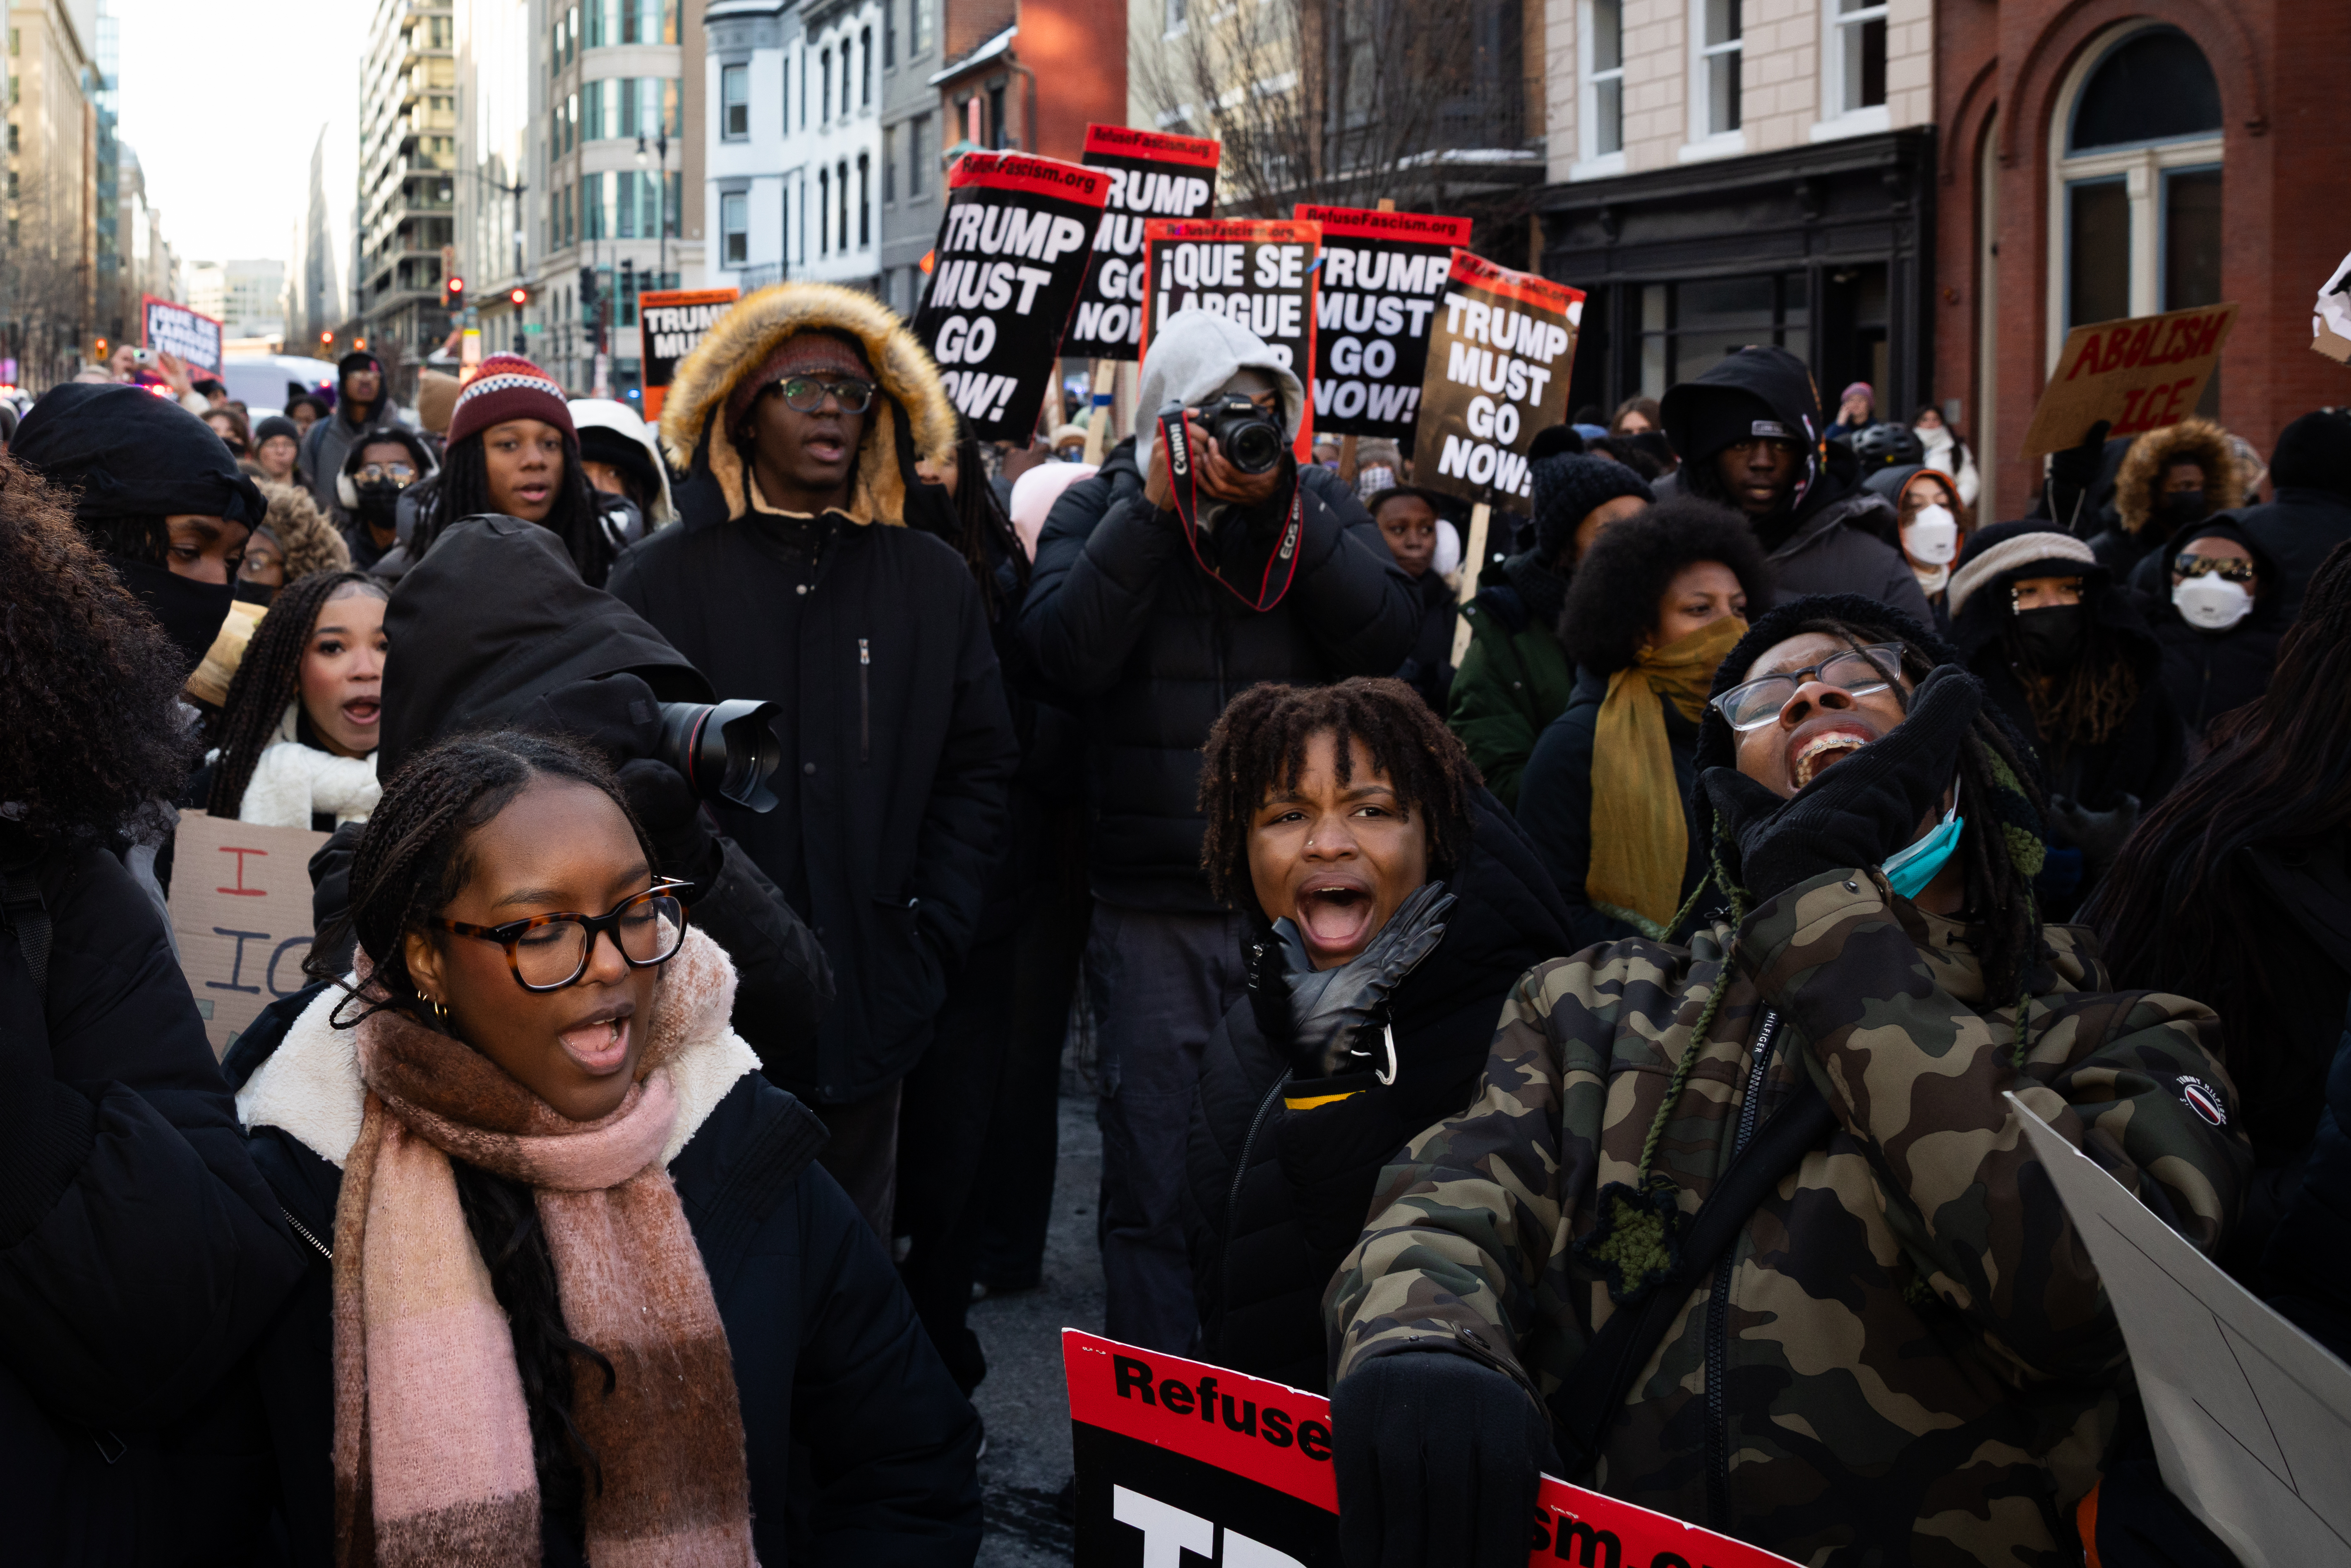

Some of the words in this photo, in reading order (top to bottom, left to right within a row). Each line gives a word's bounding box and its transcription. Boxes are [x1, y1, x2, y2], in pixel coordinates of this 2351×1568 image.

[1085, 165, 1209, 217] RUMP
[943, 204, 1085, 264] TRUMP
[1092, 213, 1146, 256] MU
[930, 260, 1052, 315] MUST
[1160, 243, 1245, 290] ¡QUE
[1254, 244, 1304, 288] SE
[643, 303, 733, 334] TRUM
[935, 315, 996, 364] GO
[1316, 291, 1435, 338] MUST
[1444, 292, 1569, 364] TRUMP
[654, 332, 706, 359] MU
[1330, 336, 1396, 379] GO
[2065, 311, 2229, 381] ABOLISH
[1447, 341, 1552, 408] MUST
[1313, 378, 1420, 423] NOW!
[1467, 395, 1520, 446] GO
[2112, 377, 2196, 435] ICE
[1170, 423, 1187, 475] Canon
[217, 846, 268, 896] I
[1754, 1012, 1776, 1053] HILFIGER
